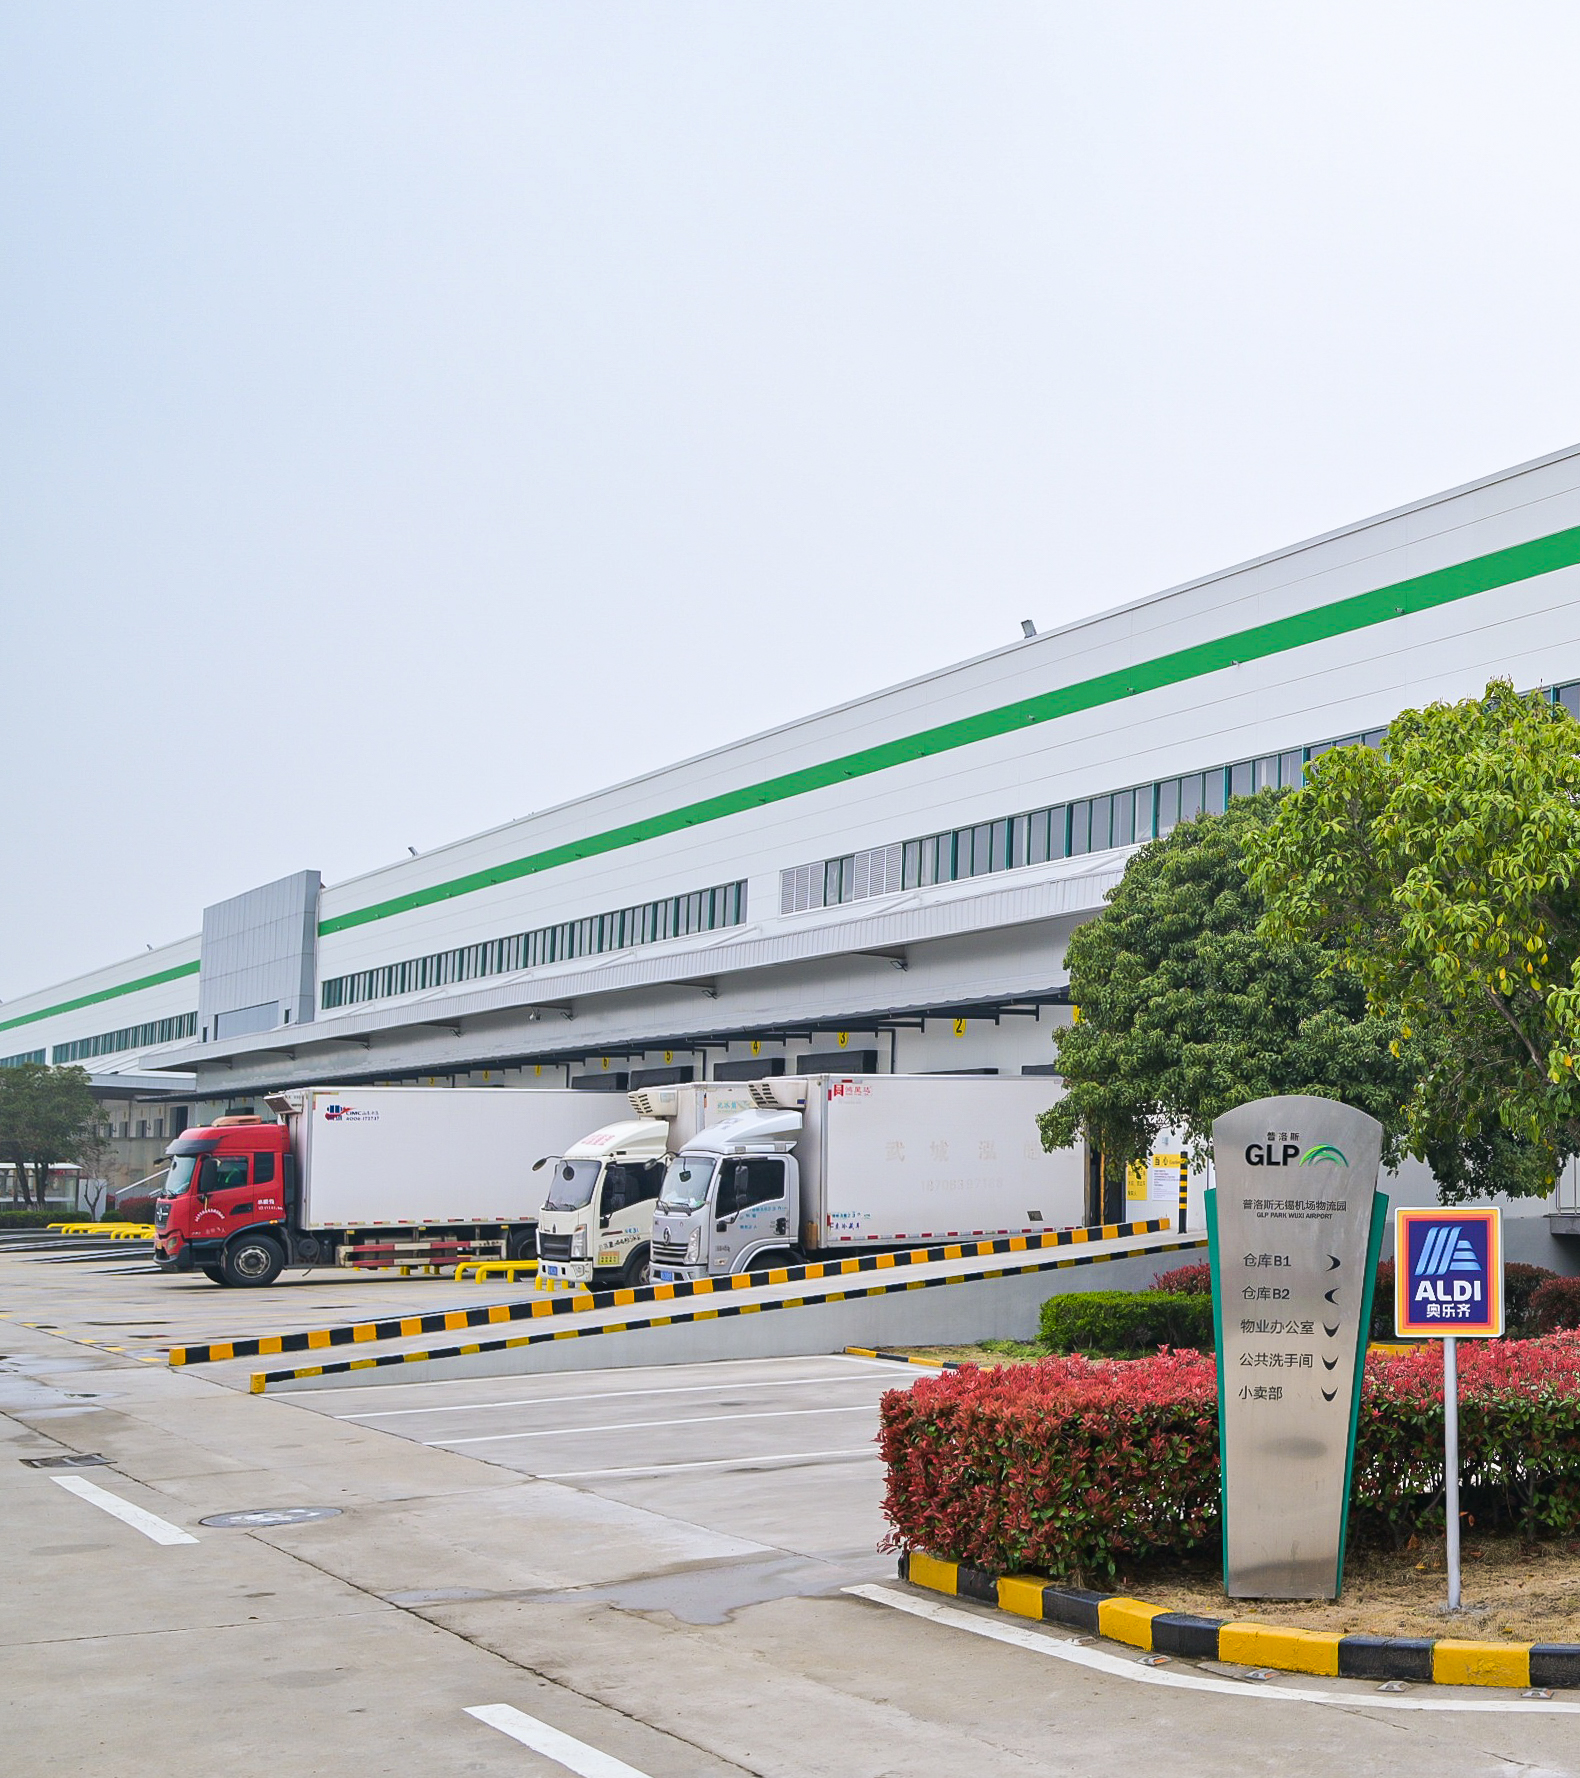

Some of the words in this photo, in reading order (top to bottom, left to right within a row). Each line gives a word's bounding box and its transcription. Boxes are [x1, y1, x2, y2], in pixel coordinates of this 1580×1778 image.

[1266, 1132, 1300, 1141] 普洛斯
[1245, 1143, 1300, 1167] GLP
[1242, 1198, 1347, 1212] 普洛斯无锡机场物流园
[1305, 1212, 1333, 1220] AIRPORT
[1243, 1253, 1292, 1268] 仓库B1
[1241, 1286, 1290, 1301] 仓库B2
[1414, 1280, 1482, 1302] ALDI
[1426, 1303, 1471, 1319] 奥乐齐
[1240, 1319, 1315, 1335] 物业办公室
[1239, 1353, 1313, 1368] 公共洗手间
[1238, 1385, 1283, 1401] 小卖部
